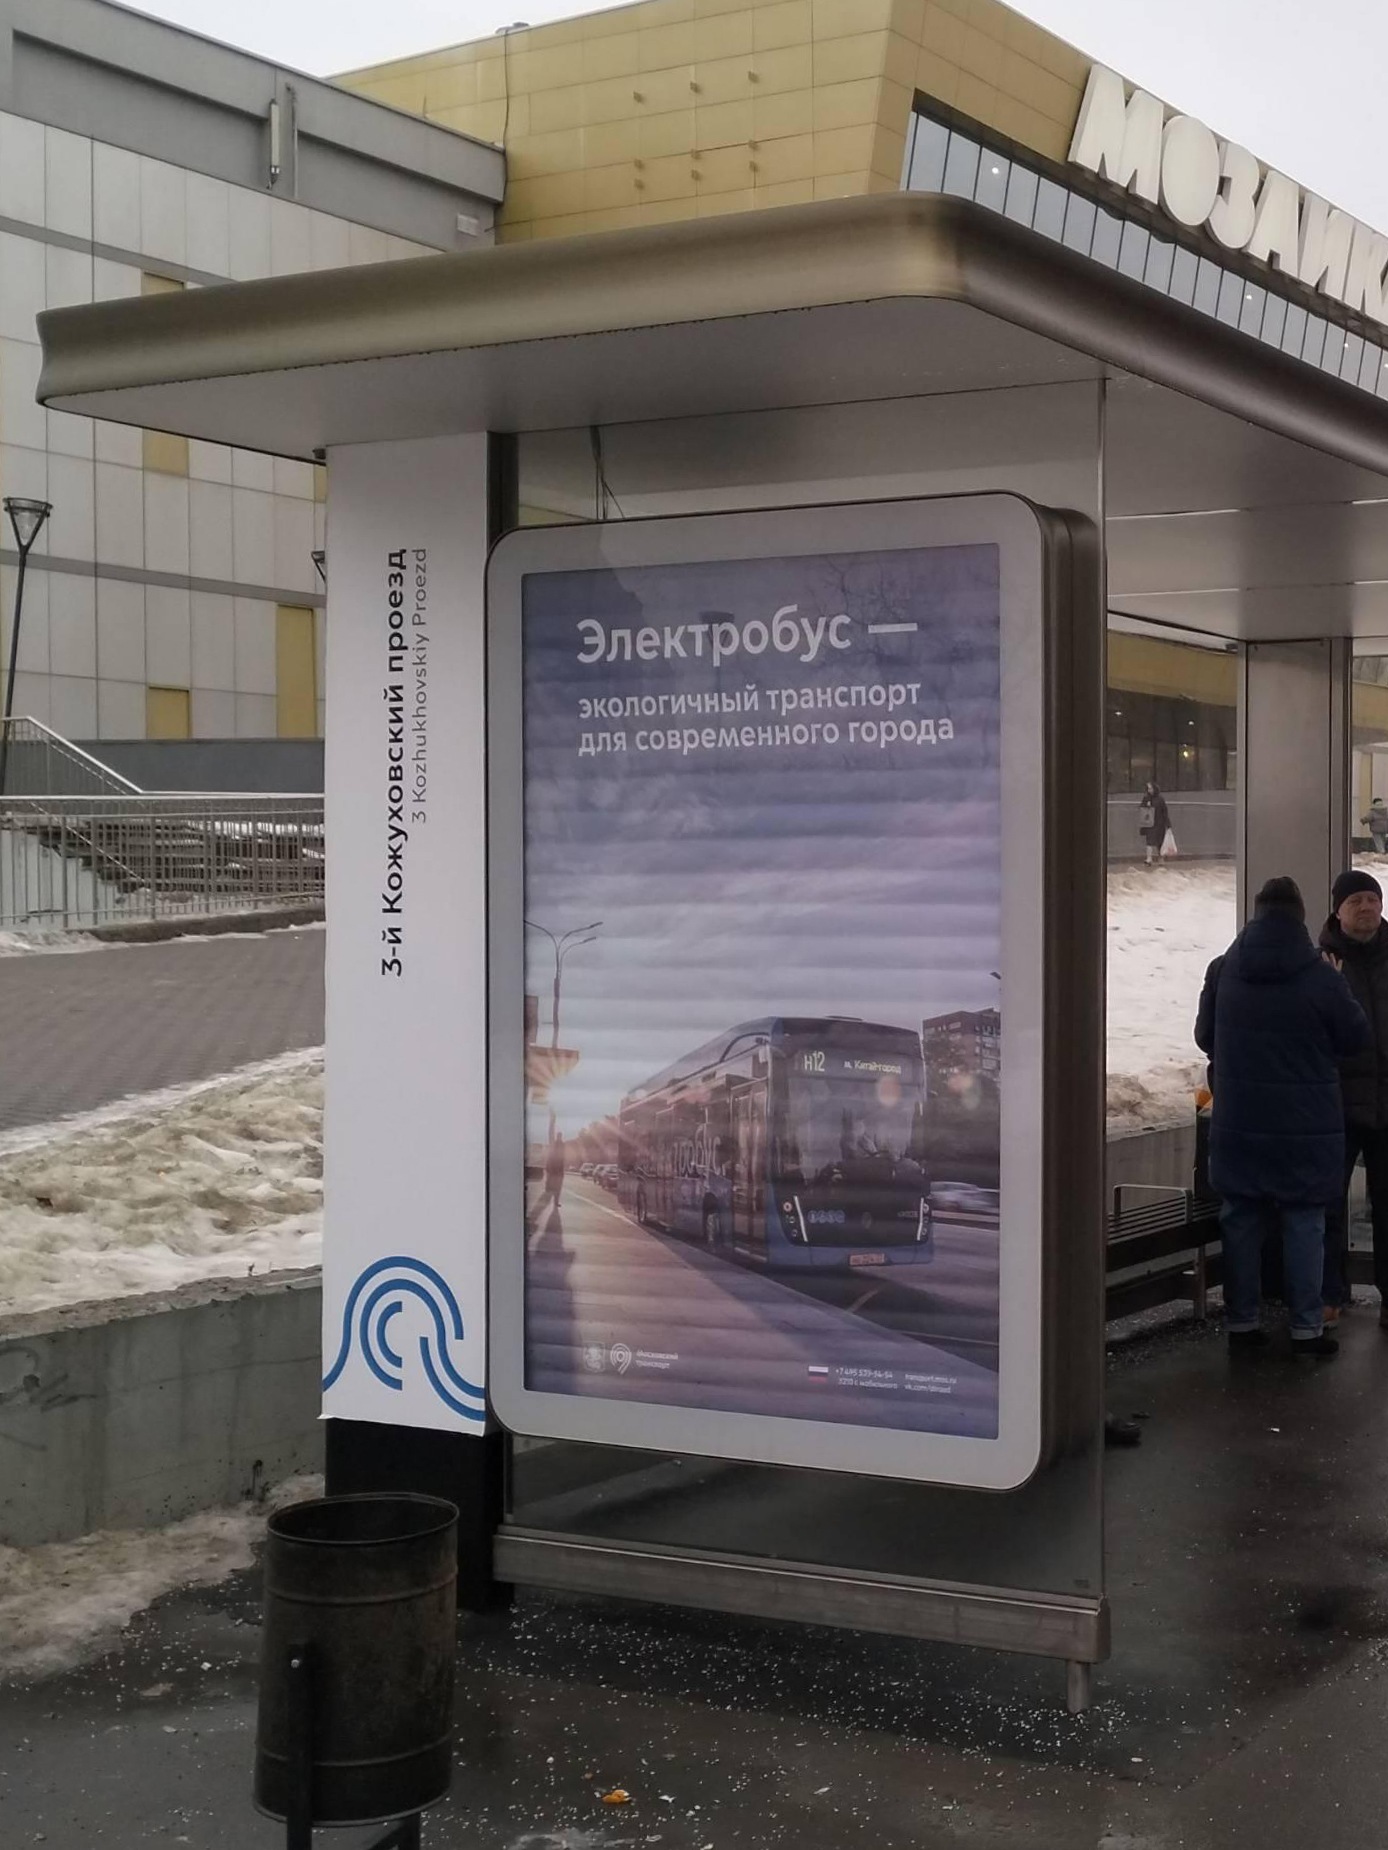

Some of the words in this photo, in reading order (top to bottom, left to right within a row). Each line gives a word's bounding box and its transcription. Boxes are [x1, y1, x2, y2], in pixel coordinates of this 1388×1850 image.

[387, 549, 407, 672] проезд
[412, 547, 427, 627] Proezd
[576, 604, 852, 667] Электробус
[412, 634, 430, 803] Kozhukhovskiy
[578, 684, 760, 719] экологичный
[766, 682, 921, 716] транспорт
[578, 731, 627, 756] для
[635, 723, 840, 755] современного
[848, 717, 954, 748] города
[382, 684, 407, 914] Кожуховский
[412, 810, 426, 824] 3
[382, 931, 402, 977] 3-й
